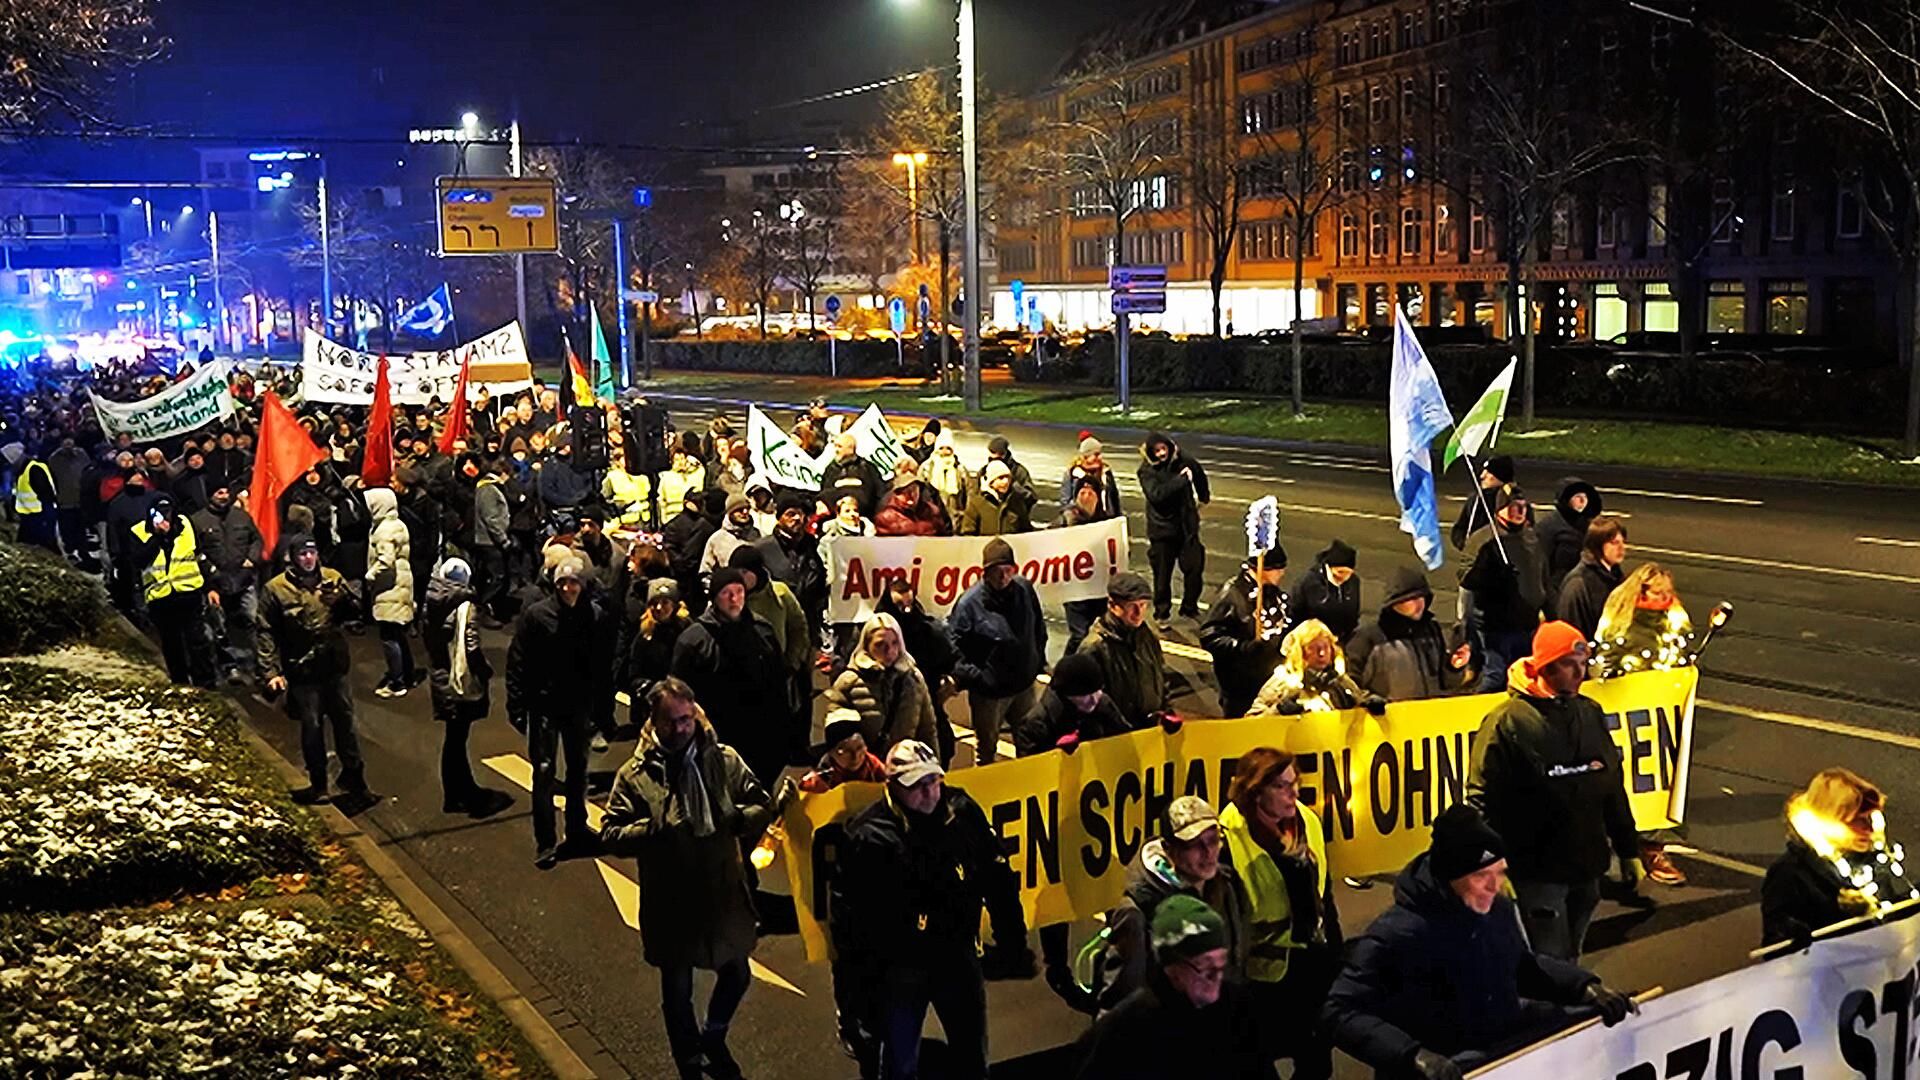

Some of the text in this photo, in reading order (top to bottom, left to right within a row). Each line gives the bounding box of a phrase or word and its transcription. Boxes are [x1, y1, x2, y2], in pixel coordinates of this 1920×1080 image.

[317, 340, 391, 373] NOR
[318, 374, 404, 396] SOFOT
[841, 557, 922, 600] Ami
[1012, 550, 1094, 584] ome
[1370, 731, 1477, 835] OHN
